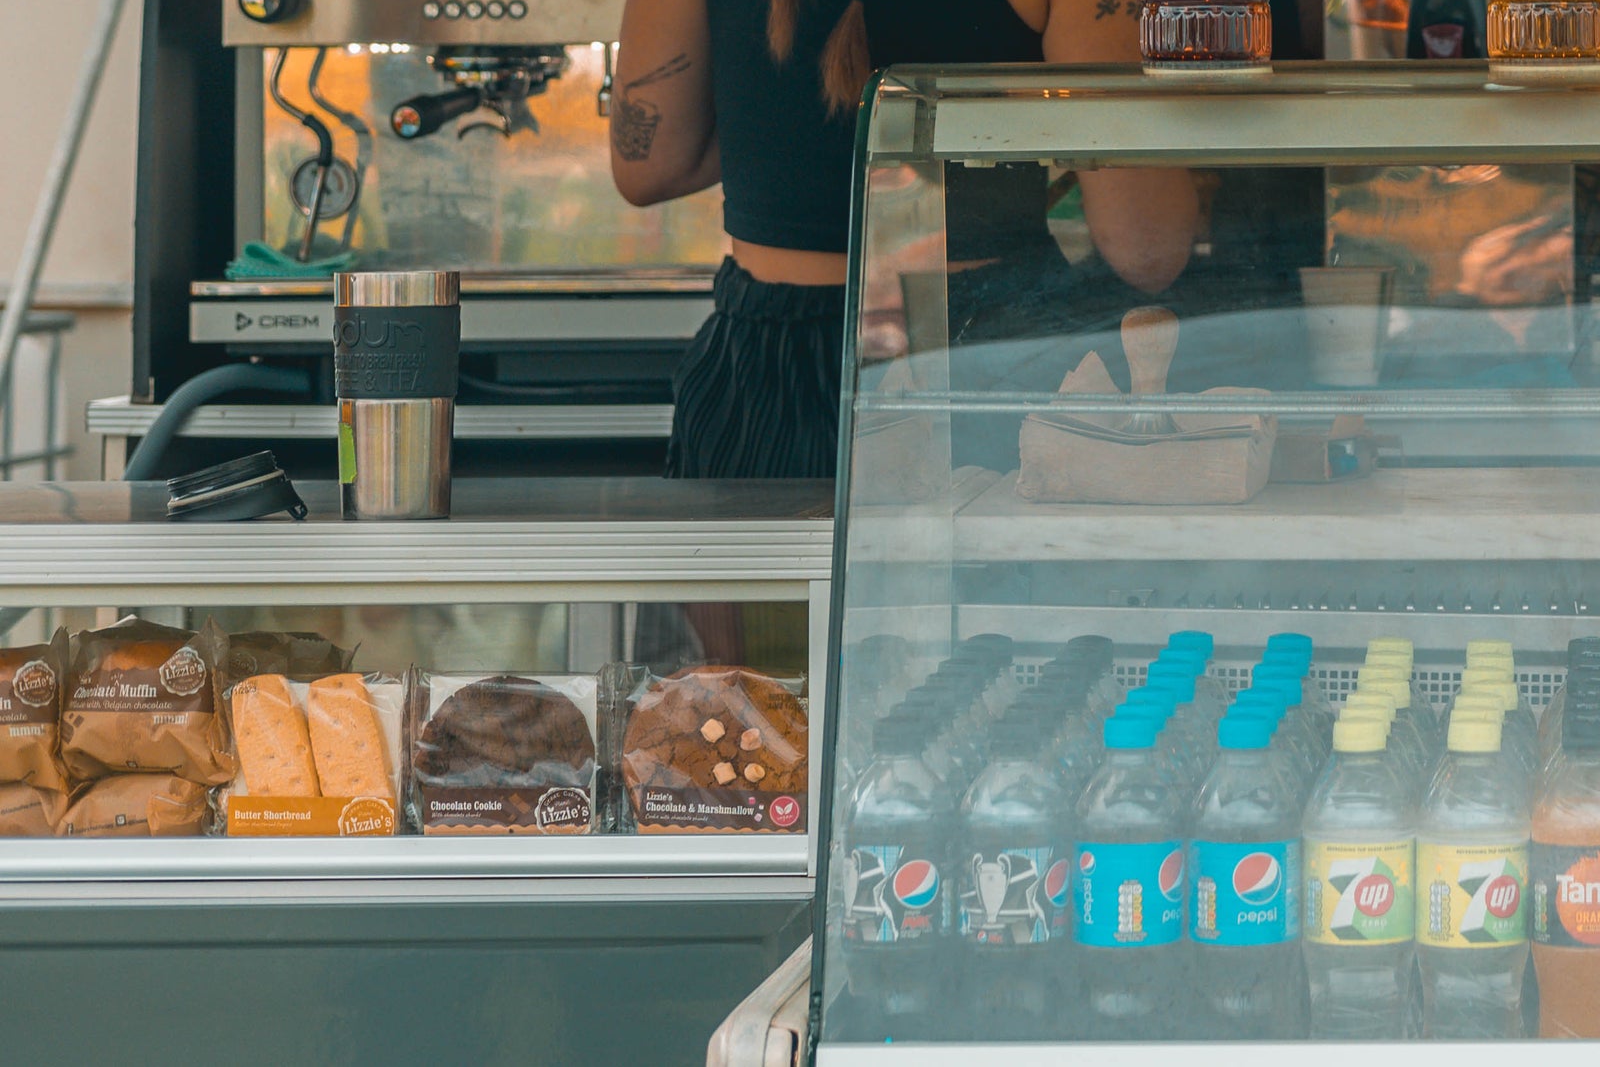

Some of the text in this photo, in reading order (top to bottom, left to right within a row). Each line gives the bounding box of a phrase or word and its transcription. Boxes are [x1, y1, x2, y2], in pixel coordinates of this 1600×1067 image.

[258, 314, 320, 329] CREM
[333, 313, 425, 349] odum
[119, 684, 157, 698] Muffin
[646, 791, 673, 801] Lizzie's
[430, 800, 502, 812] Chocolate Cookie
[646, 802, 755, 816] Chocolate & Marshmallow
[234, 810, 311, 820] Butter Shortbread
[541, 804, 589, 824] Lizzie's
[345, 815, 392, 834] Lizzie's
[1083, 878, 1094, 925] pepsi
[1237, 907, 1278, 925] pepsi
